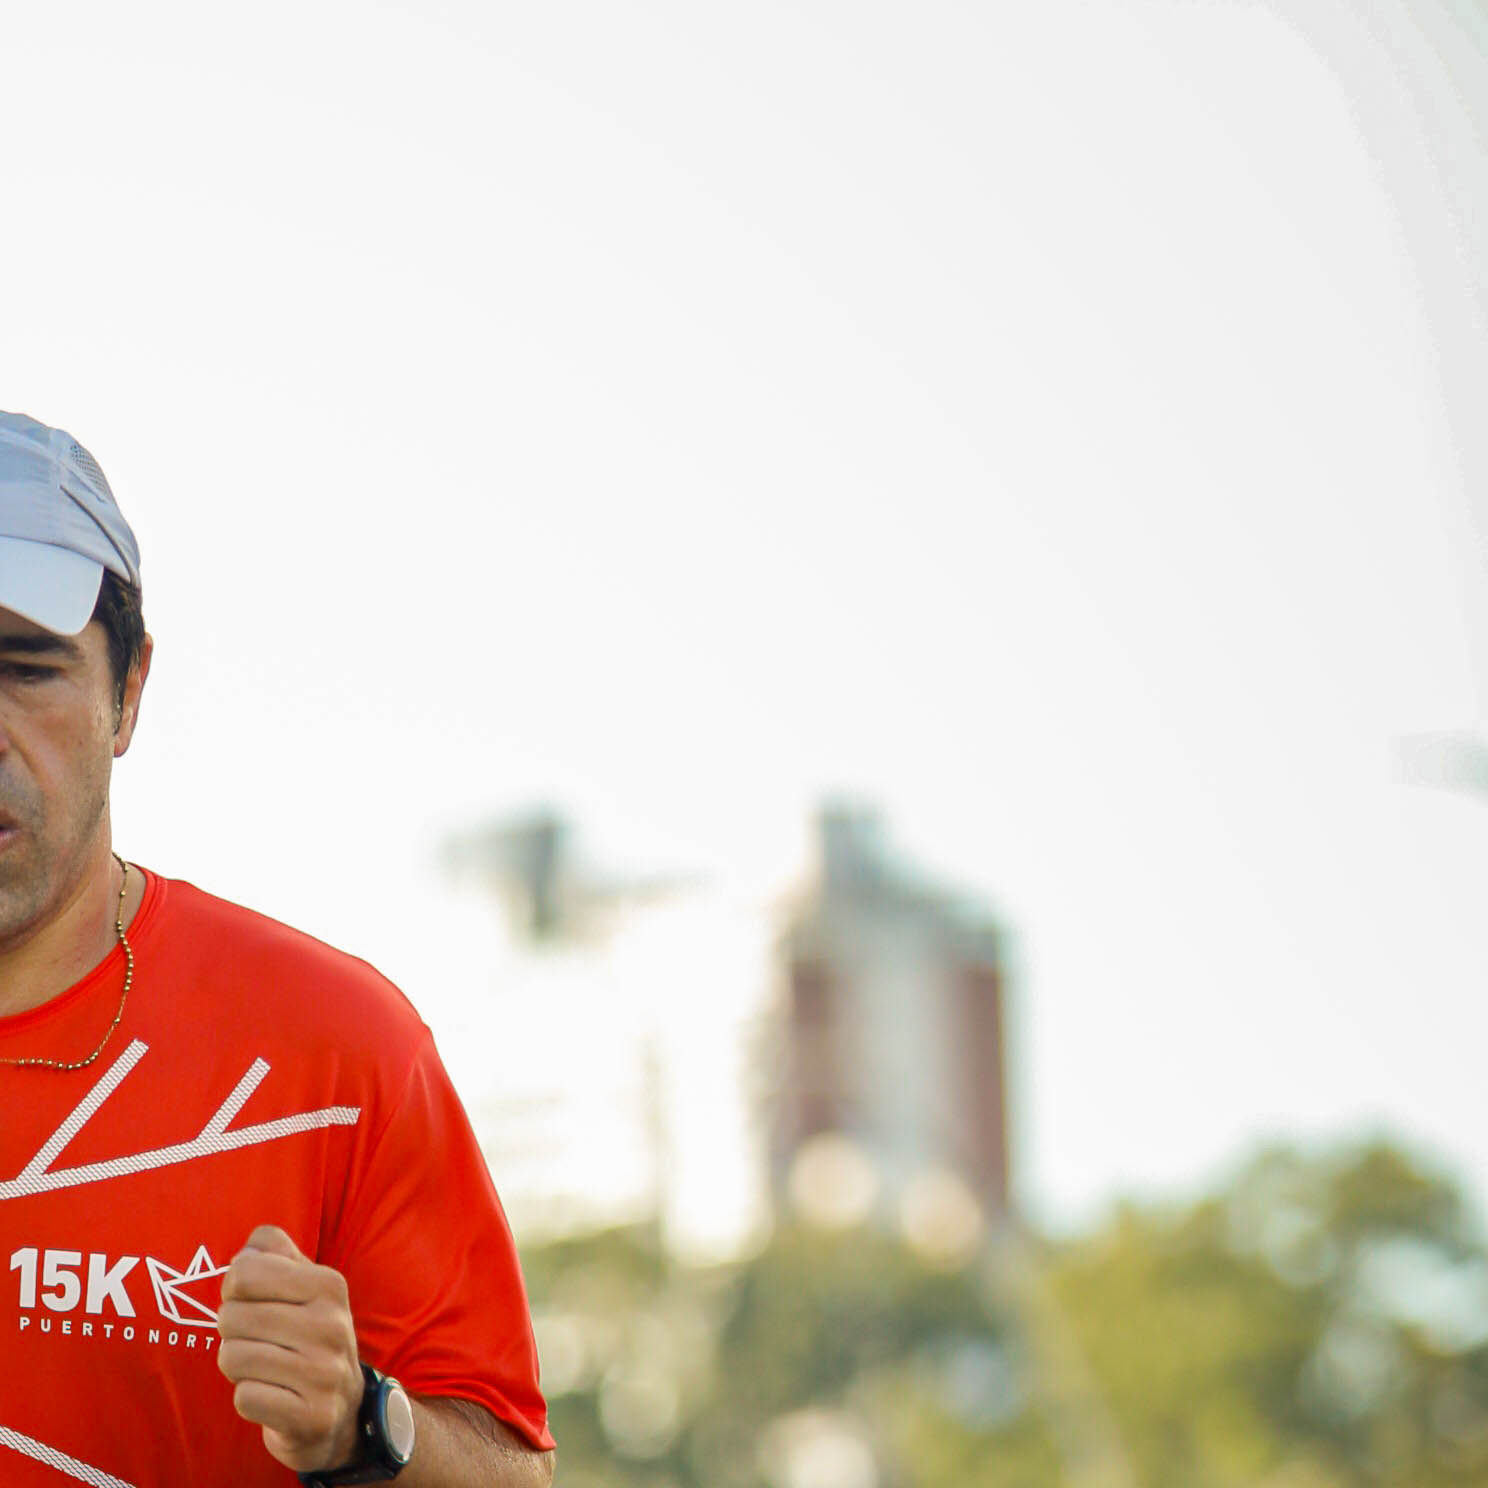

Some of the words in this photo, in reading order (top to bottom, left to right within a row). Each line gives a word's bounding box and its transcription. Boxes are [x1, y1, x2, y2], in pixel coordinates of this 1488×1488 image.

[9, 1247, 141, 1318] 15K
[19, 1316, 135, 1340] PUERTO
[148, 1329, 224, 1350] NORT
